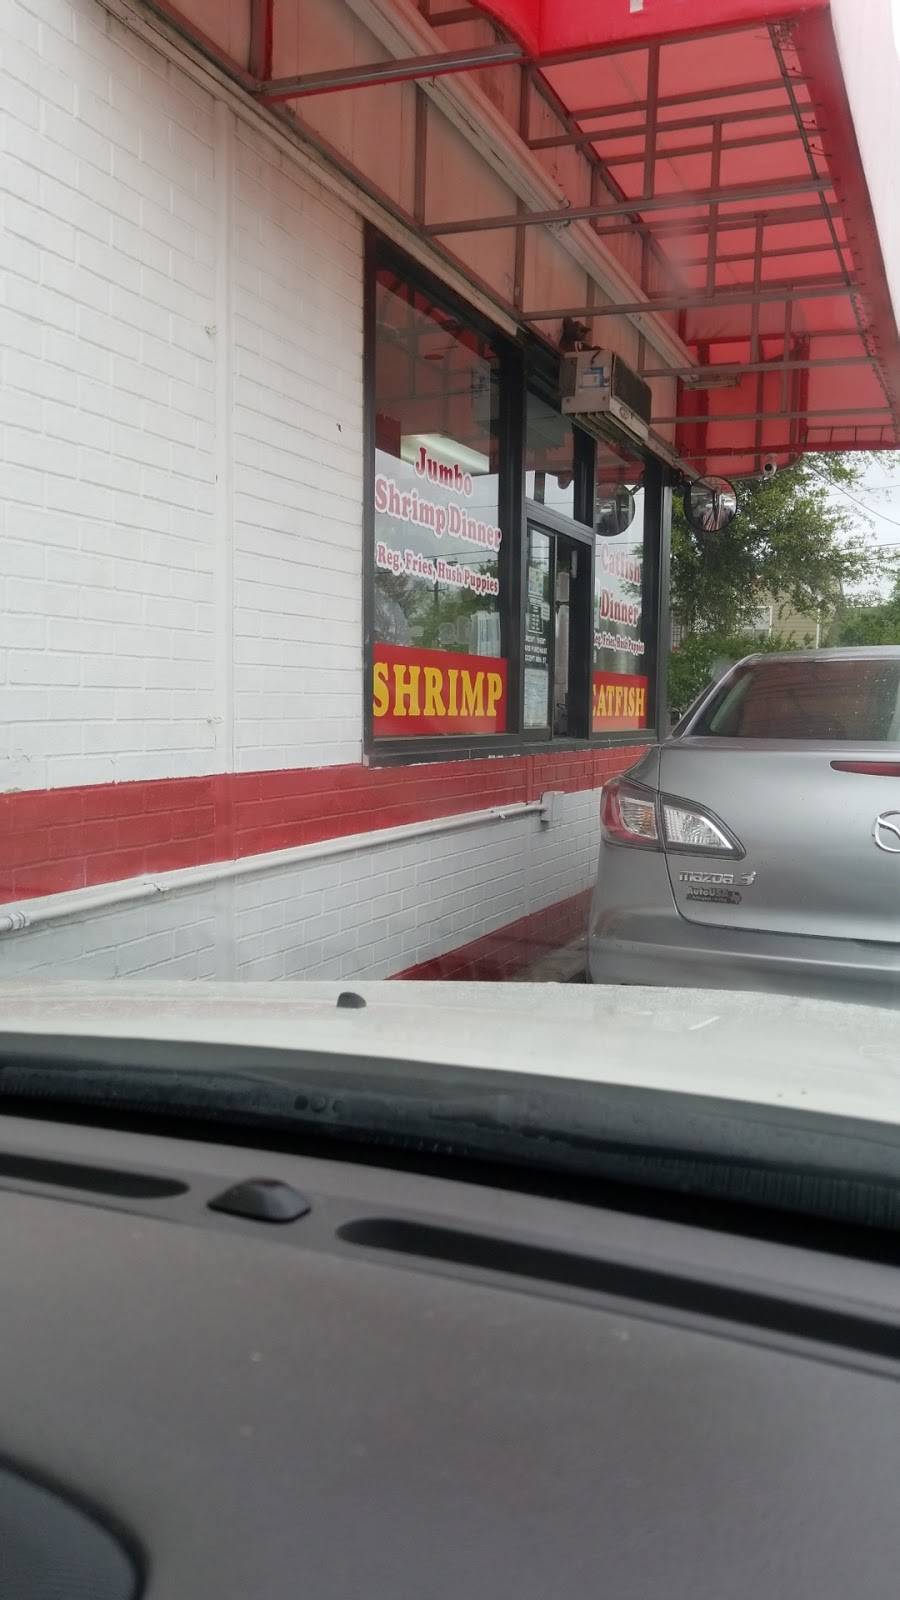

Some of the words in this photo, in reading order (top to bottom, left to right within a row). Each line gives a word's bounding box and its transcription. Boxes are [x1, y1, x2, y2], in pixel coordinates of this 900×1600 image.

[415, 447, 473, 495] Jumbo
[375, 475, 447, 536] Shrimp
[448, 503, 502, 551] Dinner
[404, 549, 437, 583] Fries,
[437, 559, 462, 585] Hush
[462, 564, 499, 595] Puppies
[600, 588, 640, 627] Dinner
[373, 662, 502, 716] SHRIMP
